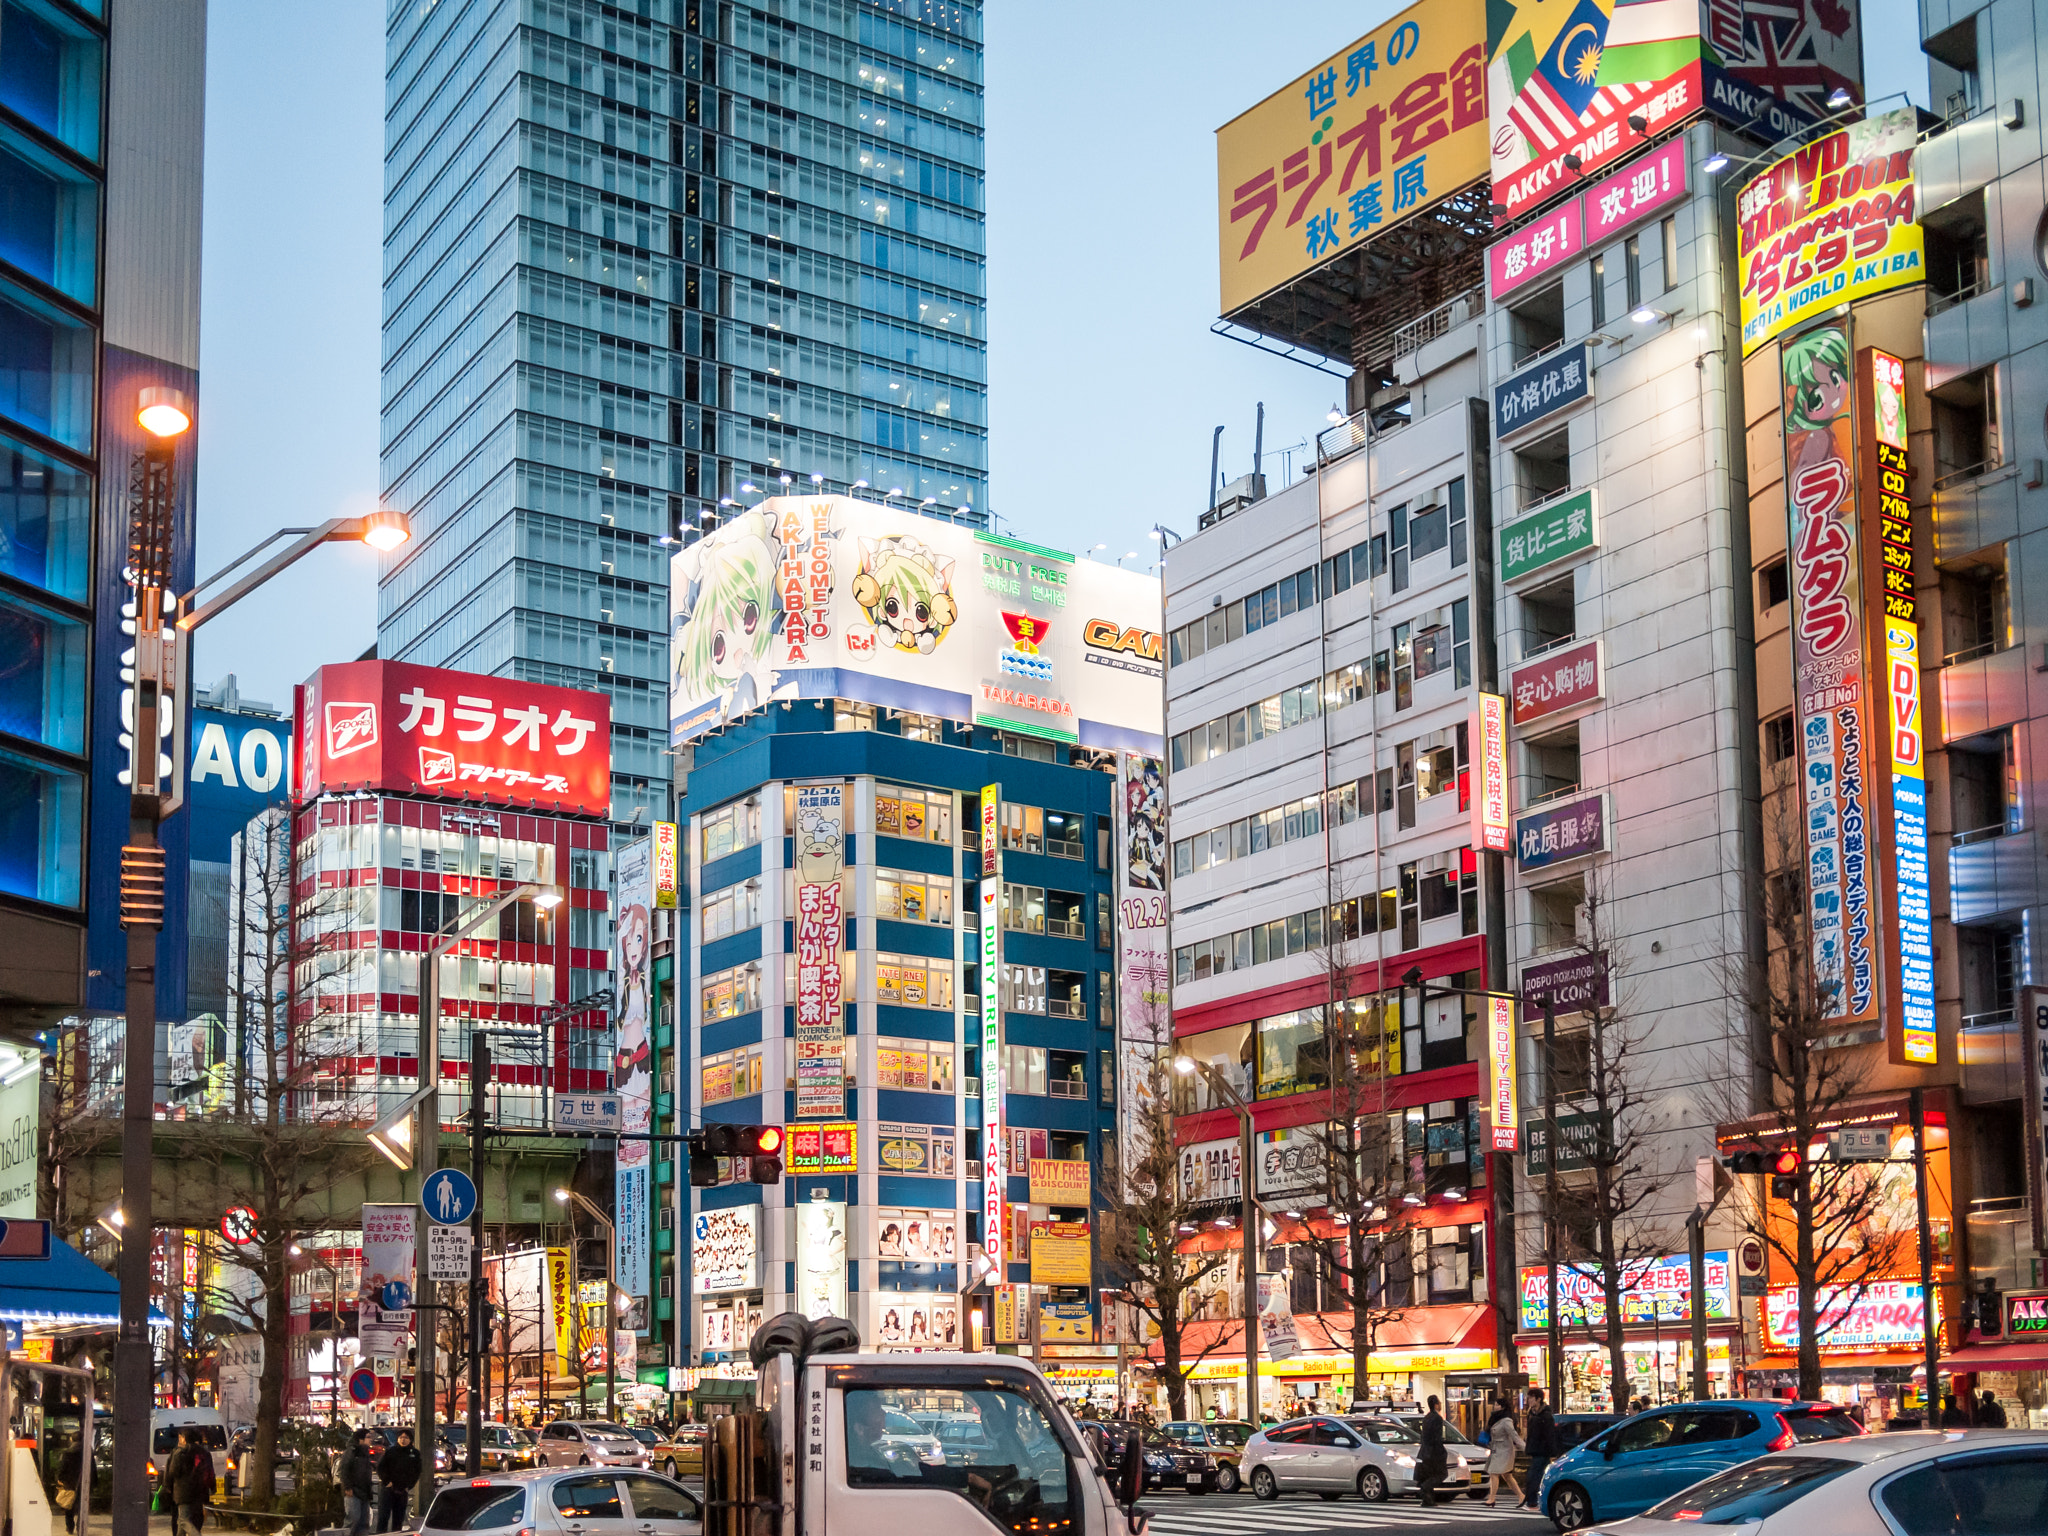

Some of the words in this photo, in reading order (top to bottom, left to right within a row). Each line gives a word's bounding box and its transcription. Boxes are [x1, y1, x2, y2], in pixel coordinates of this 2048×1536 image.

[1305, 20, 1420, 122] 世界の
[1772, 132, 1850, 196] DVD
[1506, 155, 1569, 208] AKKY
[1819, 148, 1914, 210] BOOK
[1305, 154, 1428, 259] 秋葉原
[1758, 220, 1888, 306] ラムタラ
[1744, 304, 1782, 343] MEDIA
[1789, 272, 1845, 314] WORLD
[1853, 251, 1919, 284] AKIBA
[1501, 358, 1582, 424] 价格优惠
[1879, 445, 1907, 471] ゲーム
[1883, 474, 1905, 494] CD
[1881, 495, 1910, 521] アイドル
[1506, 508, 1587, 568] 货比三家
[1882, 518, 1911, 544] アニメ
[809, 503, 831, 604] WELCOME
[1796, 459, 1850, 656] ラムタラ
[1884, 545, 1911, 569] コミック
[982, 553, 1022, 575] DUTY
[1030, 565, 1068, 586] FREE
[1887, 571, 1912, 592] ホビー
[782, 511, 809, 663] AKIHABARA
[1886, 595, 1914, 620] フィギュア
[810, 610, 831, 640] TO
[1018, 618, 1036, 637] 宝
[1799, 651, 1860, 678] メディアワールド
[1517, 659, 1594, 711] 安心购物
[1815, 670, 1841, 689] アキバ
[980, 684, 1073, 717] TAKARADA
[1892, 661, 1919, 766] DVD
[398, 687, 596, 755] カラオケ
[305, 684, 315, 794] カラオケ
[1807, 735, 1830, 749] DVD
[191, 723, 292, 795] AO
[459, 762, 569, 794] アドアーズ
[799, 787, 841, 796] コムコム
[799, 796, 841, 807] 秋葉原店
[877, 800, 898, 813] ネット
[877, 813, 898, 826] ゲーム
[984, 804, 995, 872] まんが喫茶
[1485, 827, 1506, 838] AKKY
[1487, 837, 1504, 847] ONE
[1810, 828, 1836, 843] GAME
[659, 825, 674, 891] まんが喫茶
[1812, 864, 1827, 875] PC
[1837, 706, 1873, 1017] ちょっと大人の総合メディアショップ
[1812, 873, 1838, 887] GAME
[1122, 897, 1166, 929] 12.2
[800, 884, 821, 1025] まんが喫茶
[822, 883, 841, 1022] インターネット
[985, 926, 996, 984] DUTY
[878, 968, 924, 981] INTERNET
[1525, 975, 1551, 993] ДОБРО
[879, 989, 899, 998] COMICS
[798, 1026, 835, 1034] INTERNET
[986, 994, 996, 1053] FREE
[798, 1034, 828, 1042] COMICS
[1497, 1030, 1510, 1076] DUTY
[560, 1100, 617, 1115] 万世橋
[1498, 1079, 1511, 1125] FREE
[562, 1116, 613, 1126] Manseibashi
[1494, 1129, 1516, 1139] AKKY
[796, 1133, 849, 1154] 麻雀
[1497, 1139, 1514, 1149] ONE
[795, 1155, 841, 1165] ウェルカム
[841, 1155, 851, 1164] 4F
[1031, 1161, 1059, 1180] DUTY
[1062, 1162, 1088, 1181] FREE
[1041, 1180, 1088, 1189] DISCOUNT
[1264, 1177, 1281, 1185] TOYS
[1055, 1222, 1082, 1230] DISCOUNT
[1211, 1268, 1227, 1283] 6F
[555, 1261, 565, 1337] ラジオセンター
[1056, 1309, 1089, 1317] COMPUTERS
[1832, 1335, 1873, 1344] WORLD
[1878, 1332, 1920, 1342] AKIBA
[1304, 1362, 1323, 1372] Radio
[1324, 1361, 1337, 1371] hall
[811, 1390, 822, 1437] 株式会社
[810, 1443, 822, 1472] 誠和
